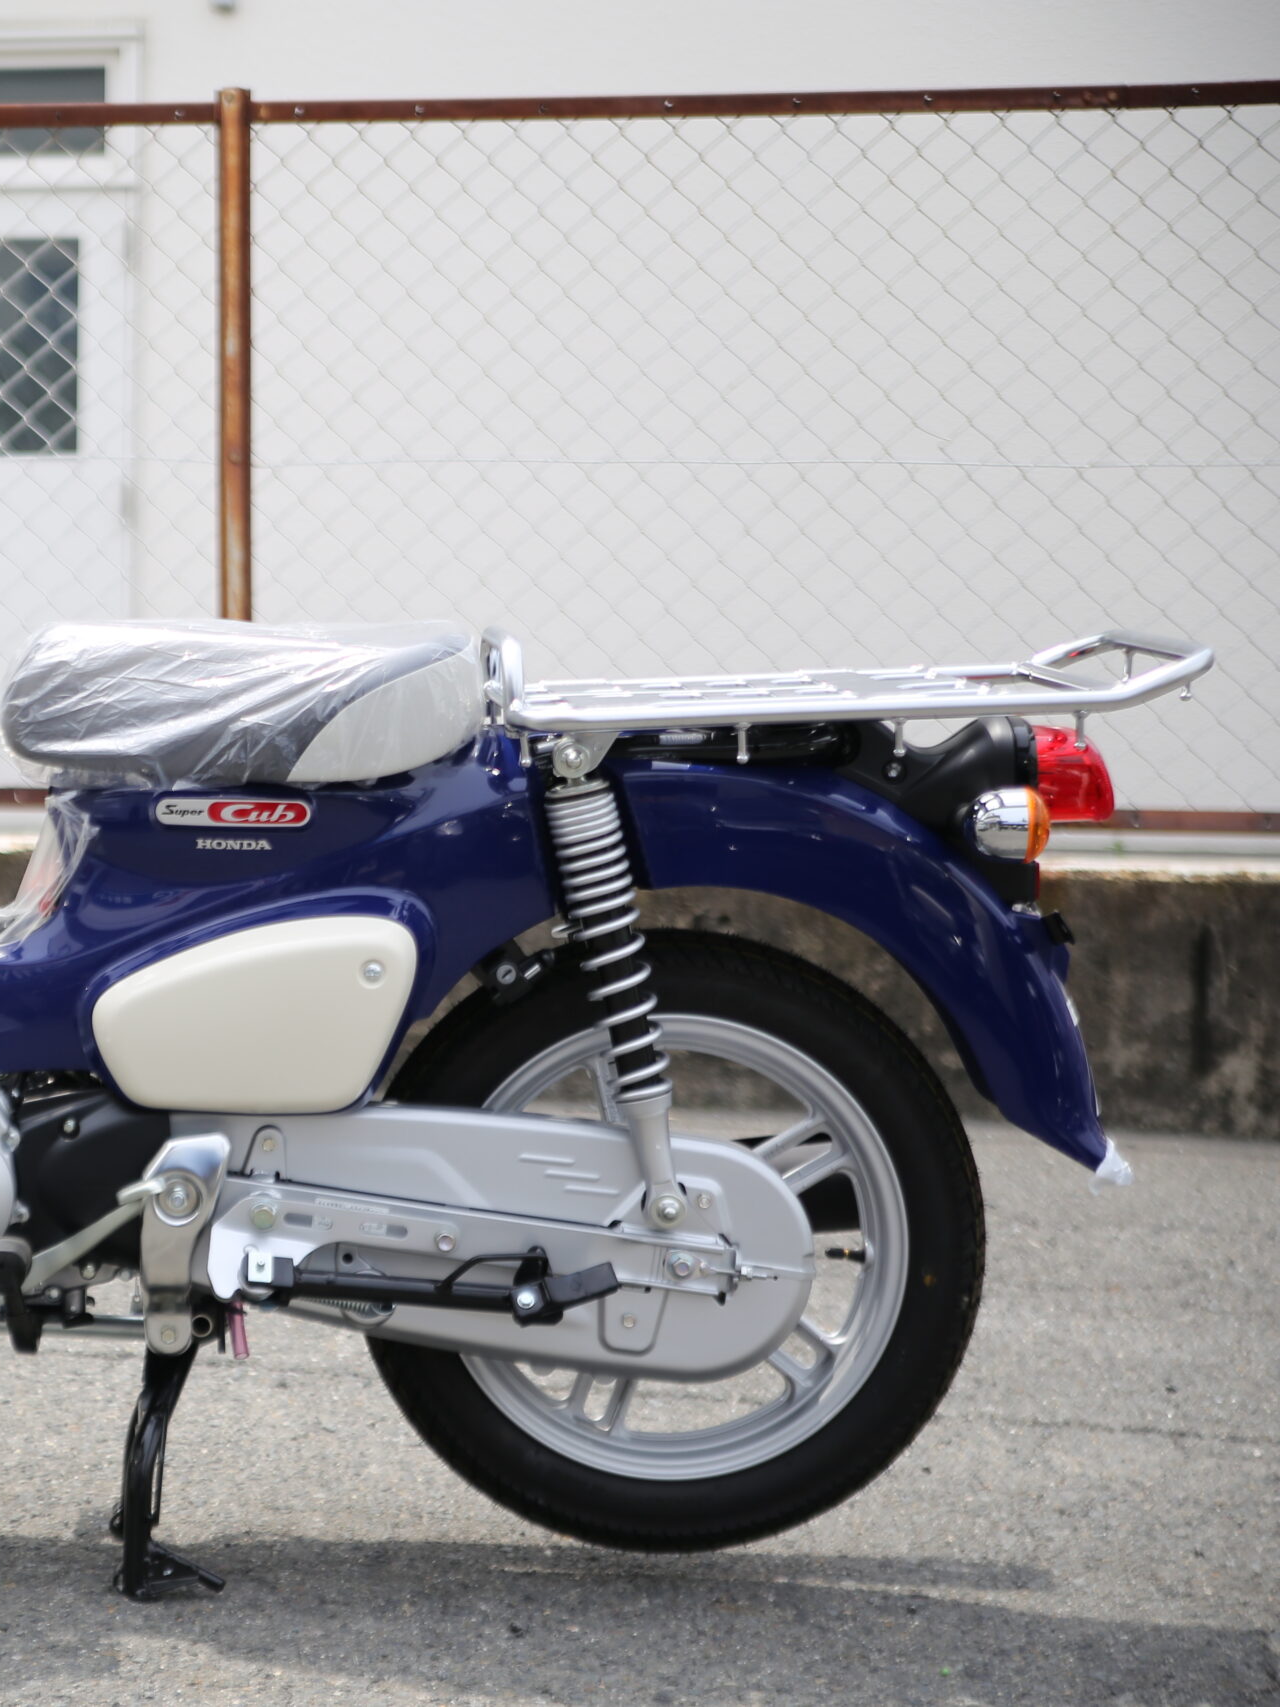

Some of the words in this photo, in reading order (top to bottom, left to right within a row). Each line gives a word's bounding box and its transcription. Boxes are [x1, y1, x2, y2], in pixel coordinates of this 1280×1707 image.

[161, 804, 205, 817] Super
[220, 804, 296, 823] Cub
[196, 838, 272, 850] HONDA
